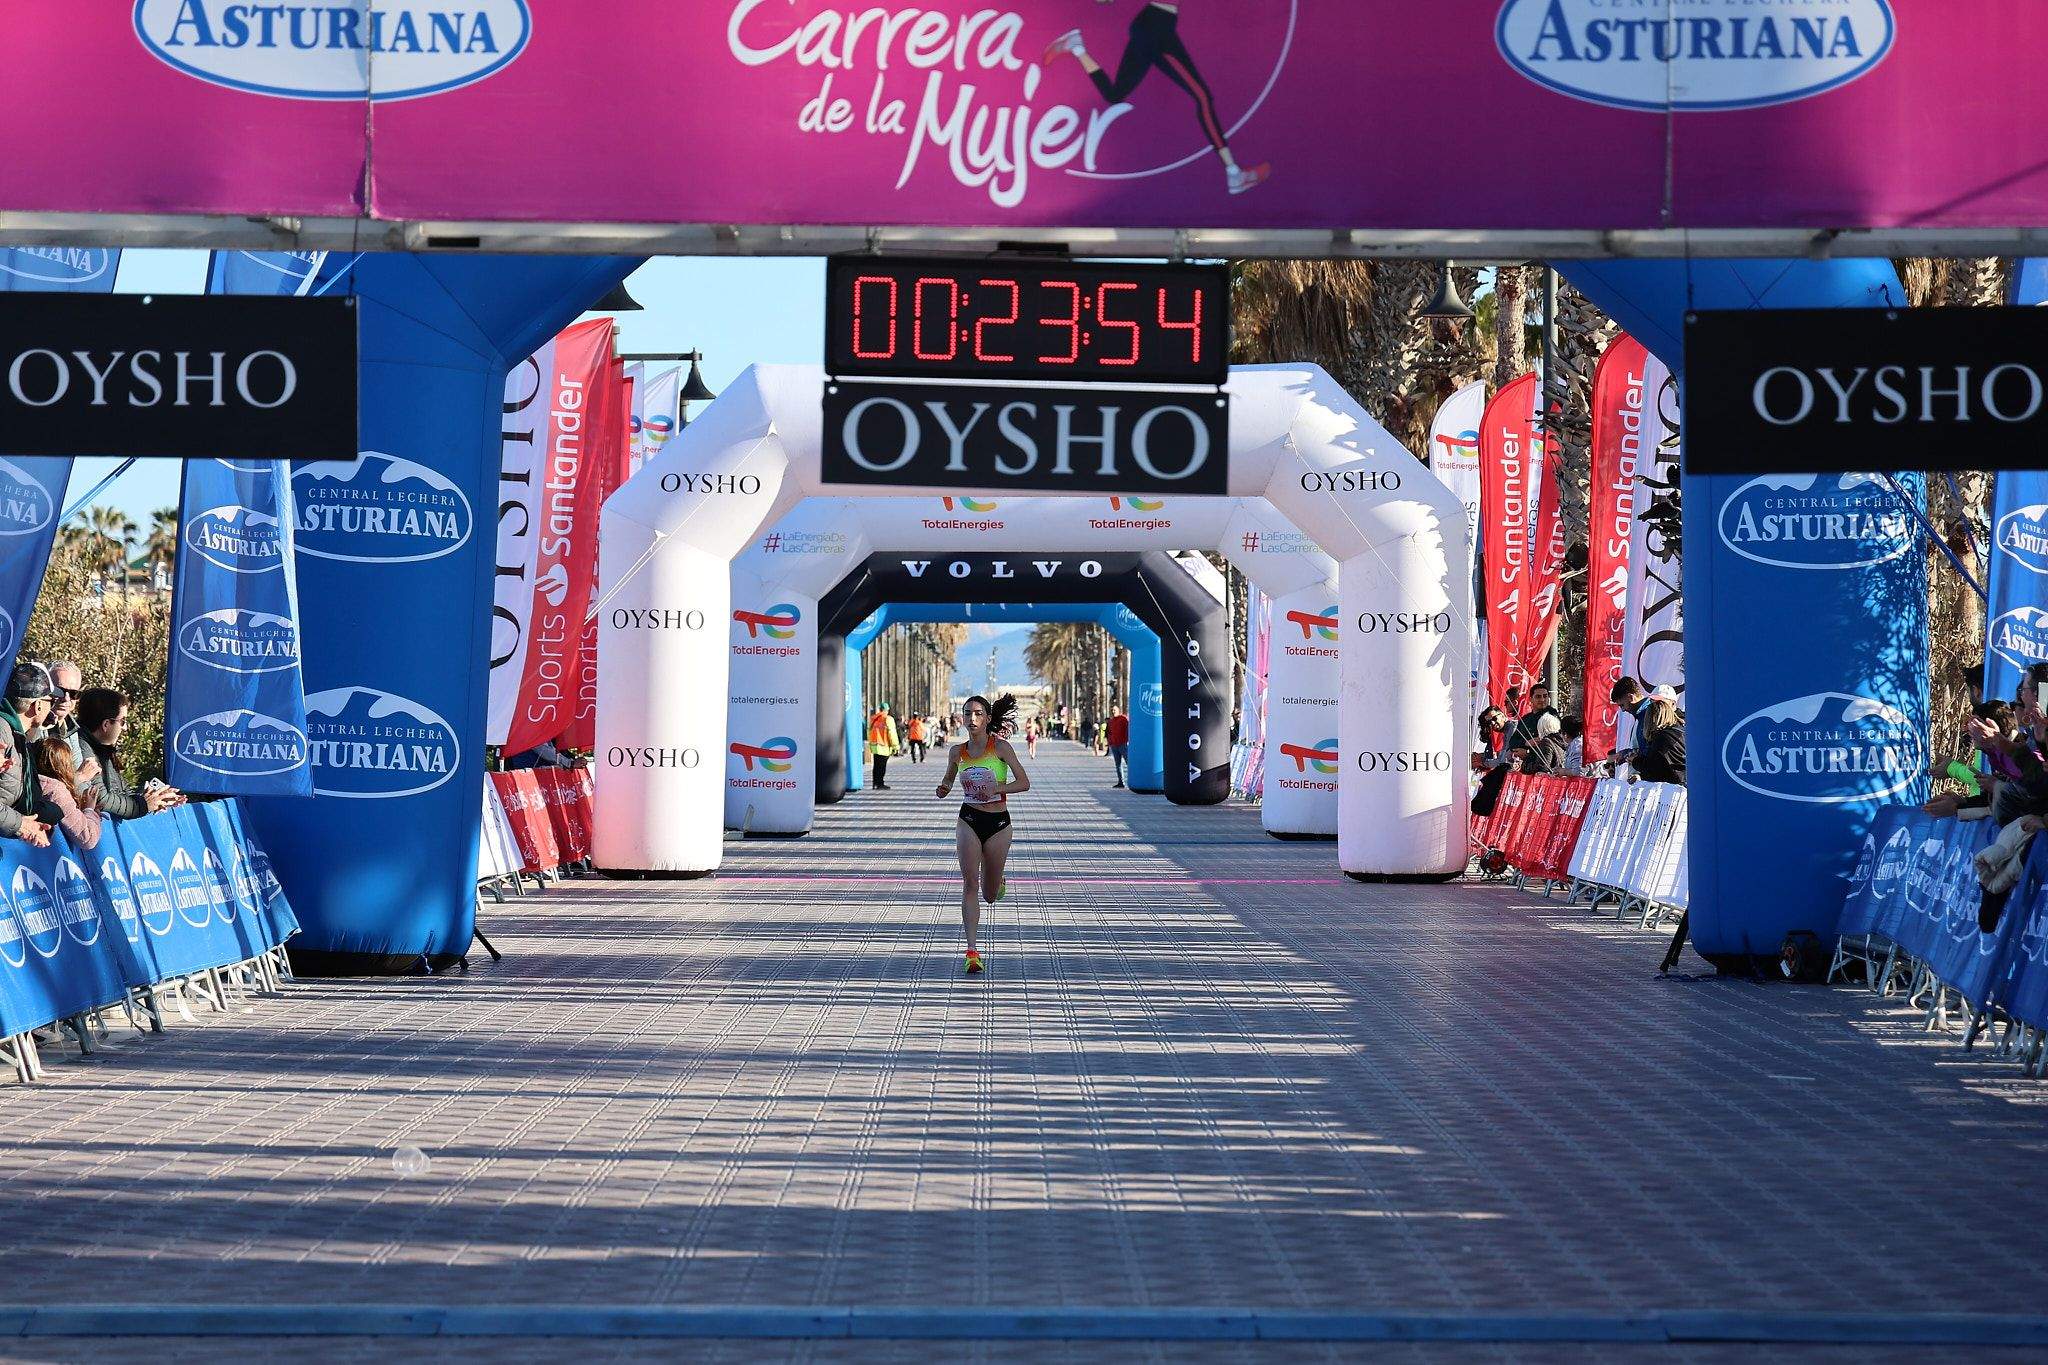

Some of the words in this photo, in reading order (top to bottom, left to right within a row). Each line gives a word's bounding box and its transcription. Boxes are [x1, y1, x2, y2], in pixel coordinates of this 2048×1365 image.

[165, 0, 499, 54] ASTURIANA
[726, 0, 1025, 71] Carrera
[1528, 0, 1864, 61] ASTURIANA
[799, 72, 854, 133] de
[866, 72, 906, 134] la
[897, 65, 1134, 208] Mujer
[853, 276, 1202, 364] 00:23:54
[8, 348, 297, 408] OYSHO
[1753, 363, 2043, 426] OYSHO
[842, 396, 1210, 480] OYSHO
[542, 373, 583, 557] Santander
[1608, 372, 1645, 559] Santander
[661, 473, 760, 495] OYSHO
[1301, 471, 1401, 492] OYSHO
[308, 488, 379, 500] CENTRAL
[387, 491, 456, 506] LECHERA
[1500, 427, 1523, 583] Santander
[1765, 498, 1838, 509] CENTRAL
[922, 519, 1004, 531] TotalEnergies
[1089, 518, 1171, 531] TotalEnergies
[901, 561, 1101, 578] VOLVO
[612, 608, 704, 630] OYSHO
[1358, 612, 1451, 633] OYSHO
[187, 626, 298, 658] ASTURIANA
[732, 646, 800, 658] TotalEnergies
[528, 614, 565, 722] Sports
[1603, 617, 1626, 727] Sorts
[731, 696, 799, 706] totalenergies.es
[1187, 640, 1201, 783] VOLVO
[205, 729, 247, 739] CENTRAL
[250, 733, 297, 741] LECHERA
[375, 726, 443, 740] LECHERA
[1768, 731, 1841, 741] CENTRAL
[182, 730, 301, 760] ASTURIANA
[608, 746, 700, 768] OYSHO
[1358, 751, 1451, 772] OYSHO
[728, 778, 797, 790] TotalEnergies
[1279, 779, 1338, 791] TotalEnergi
